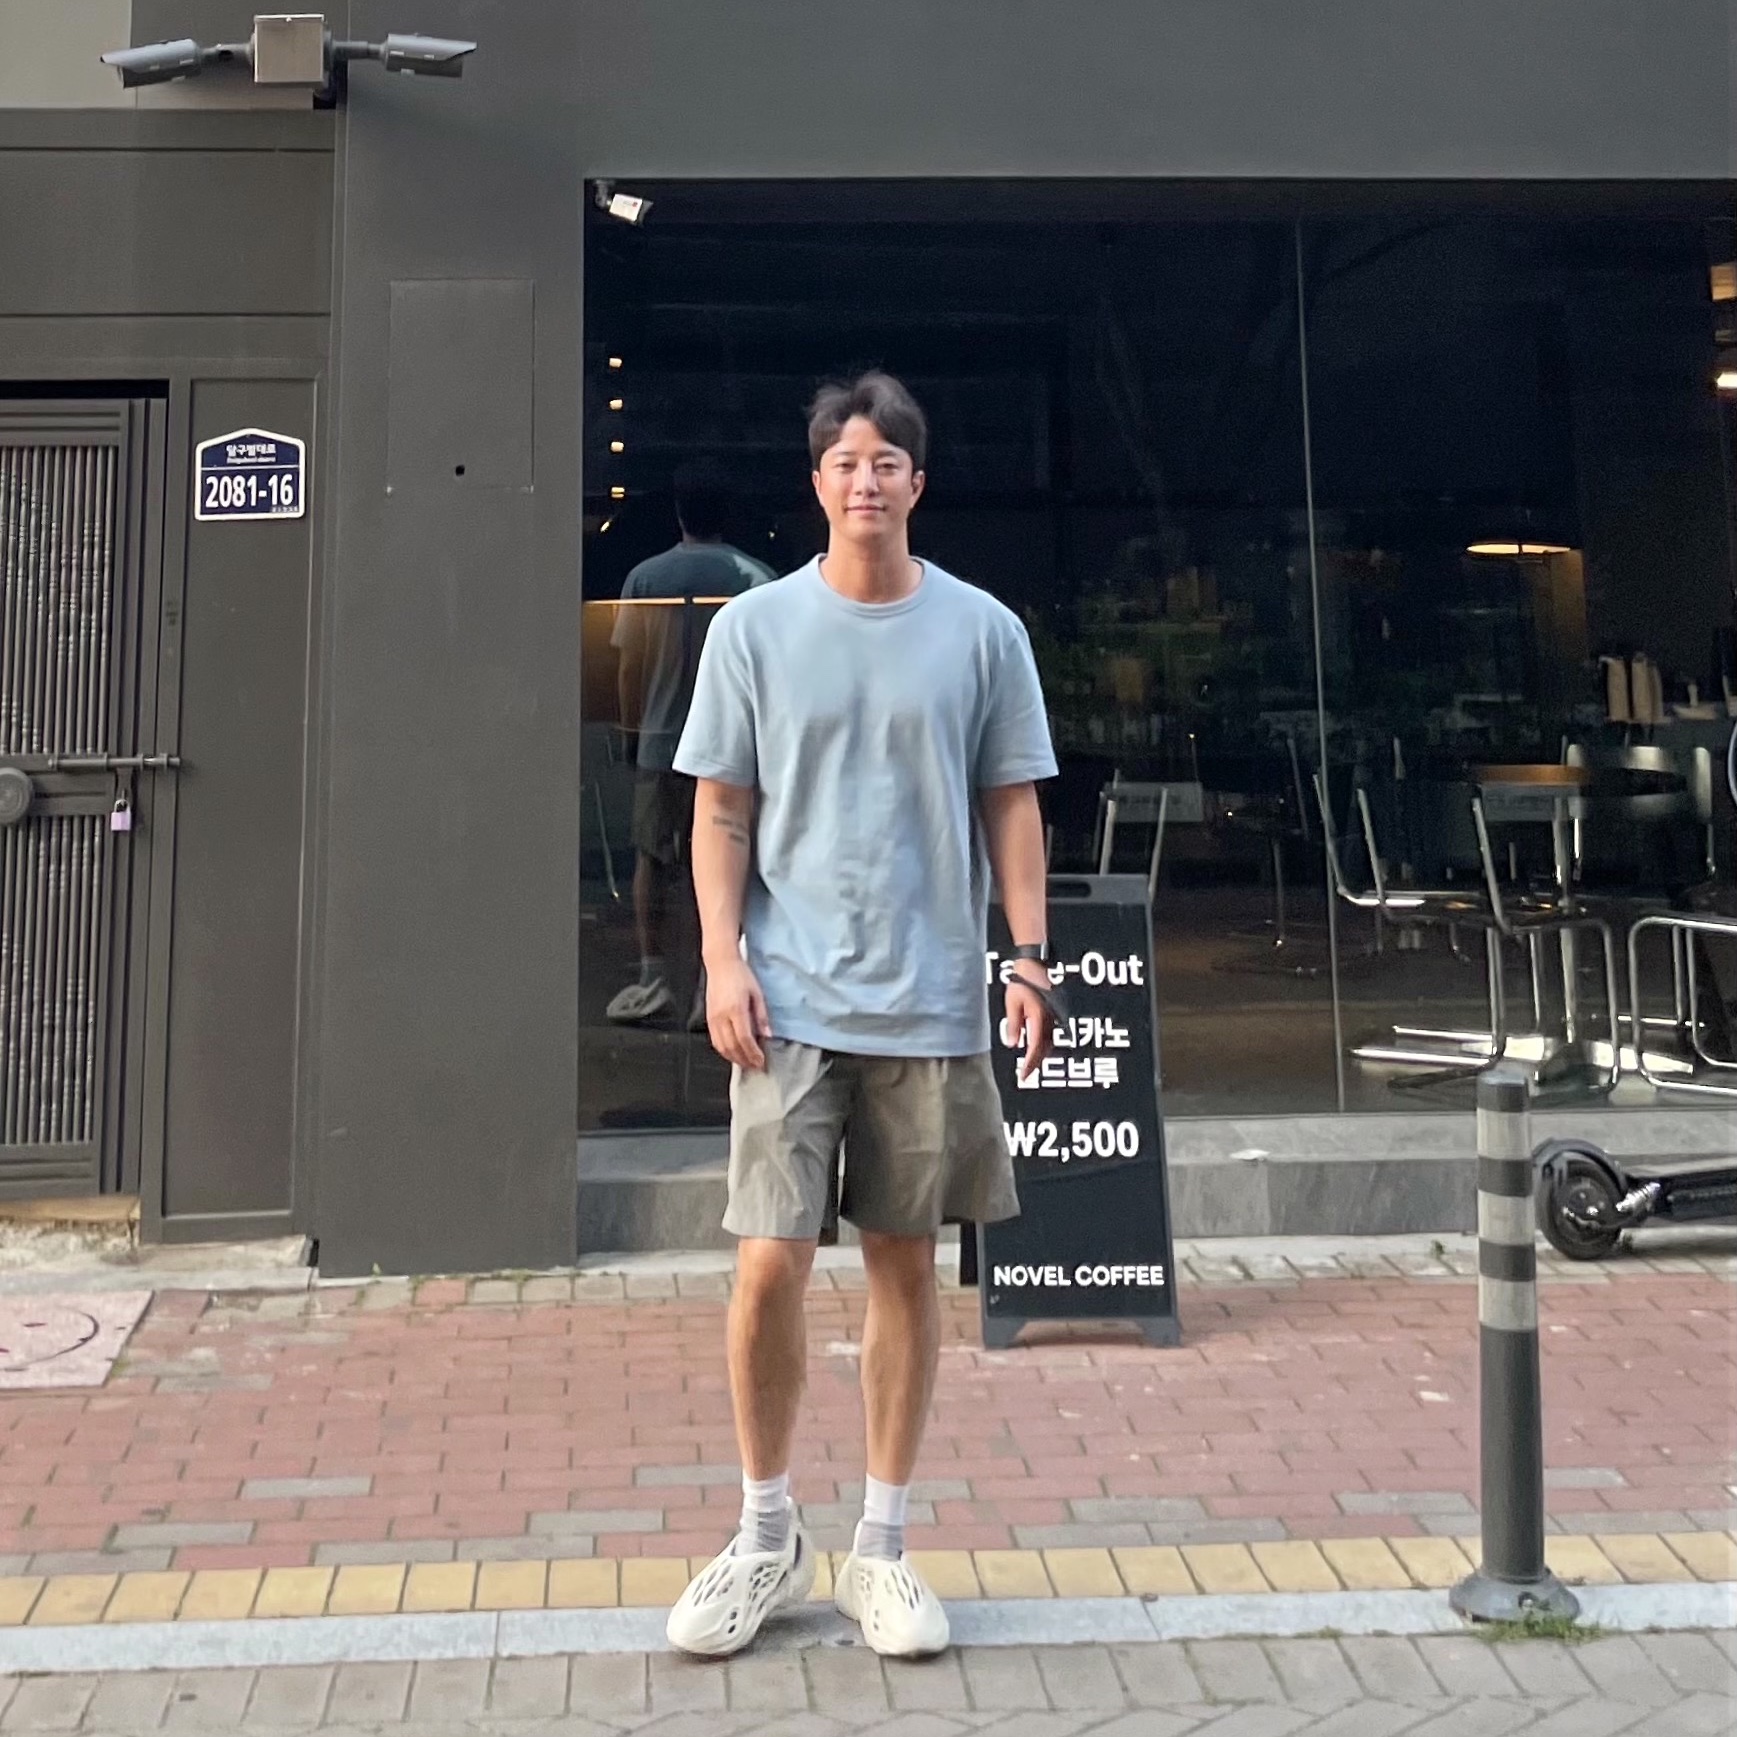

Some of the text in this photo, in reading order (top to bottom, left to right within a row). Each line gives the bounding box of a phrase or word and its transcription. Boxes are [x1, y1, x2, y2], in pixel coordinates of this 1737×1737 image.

[205, 474, 294, 508] 2081-16
[985, 951, 1144, 986] Tae-Out
[994, 1265, 1164, 1287] NOVEL COFFEE
